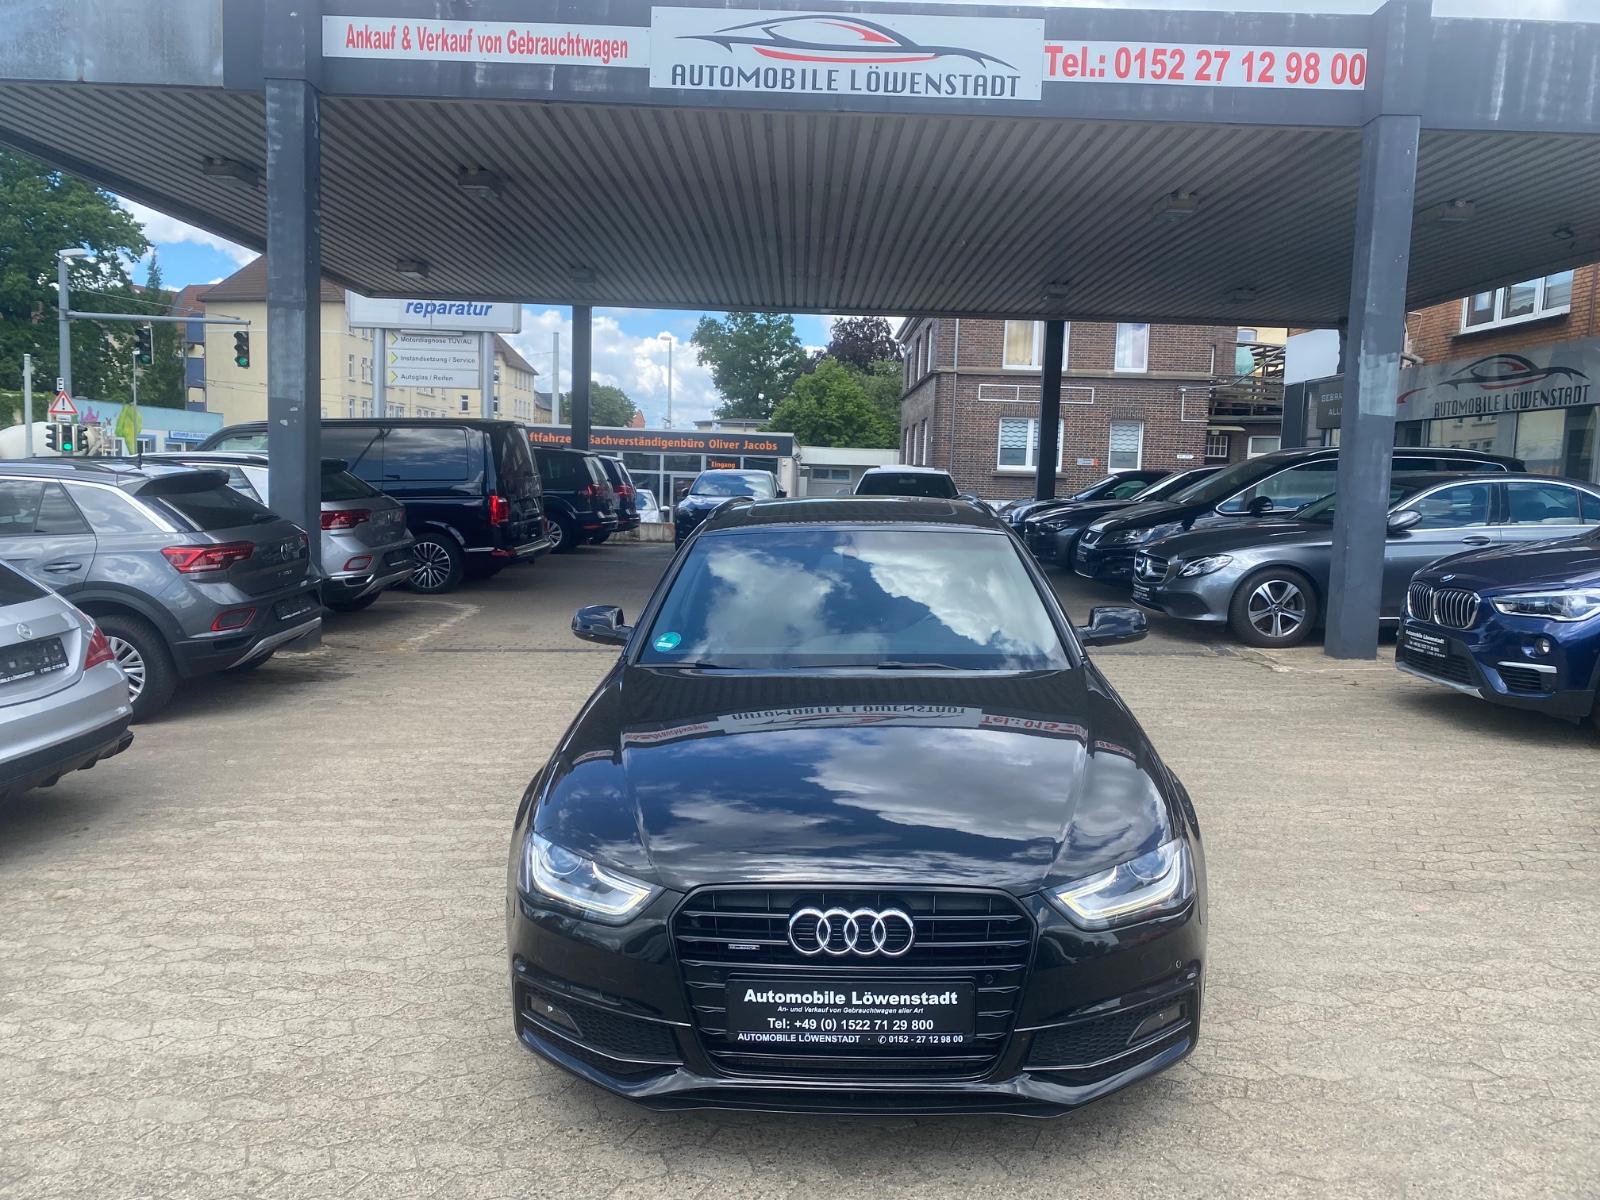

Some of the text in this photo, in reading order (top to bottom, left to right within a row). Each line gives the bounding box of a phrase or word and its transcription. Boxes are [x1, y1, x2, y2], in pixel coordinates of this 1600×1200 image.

[346, 23, 628, 64] Ankauf & Verkauf von Gebrauchtwagen
[1045, 46, 1366, 85] Tel.: 0152 27 12 98 00
[672, 64, 1021, 98] AUTOMOBILE LÖWENSTADT
[405, 301, 492, 317] reparatur
[1434, 385, 1591, 418] AUTOMOBILE LÖWENSTADT
[708, 438, 740, 450] Oliver
[743, 439, 778, 451] Jacobs
[711, 461, 736, 470] Eingang
[744, 989, 958, 1005] Automobile Löwenstadt
[768, 1018, 934, 1031] Tel: +49 (0) 1522 71 29 800
[737, 1033, 797, 1042] AUTOMOBILE
[799, 1032, 860, 1043] LÖWENSTADT
[888, 1034, 909, 1043] 0152
[916, 1035, 928, 1043] 27
[929, 1035, 939, 1043] 12
[940, 1035, 951, 1043] 98
[953, 1035, 964, 1043] 00
